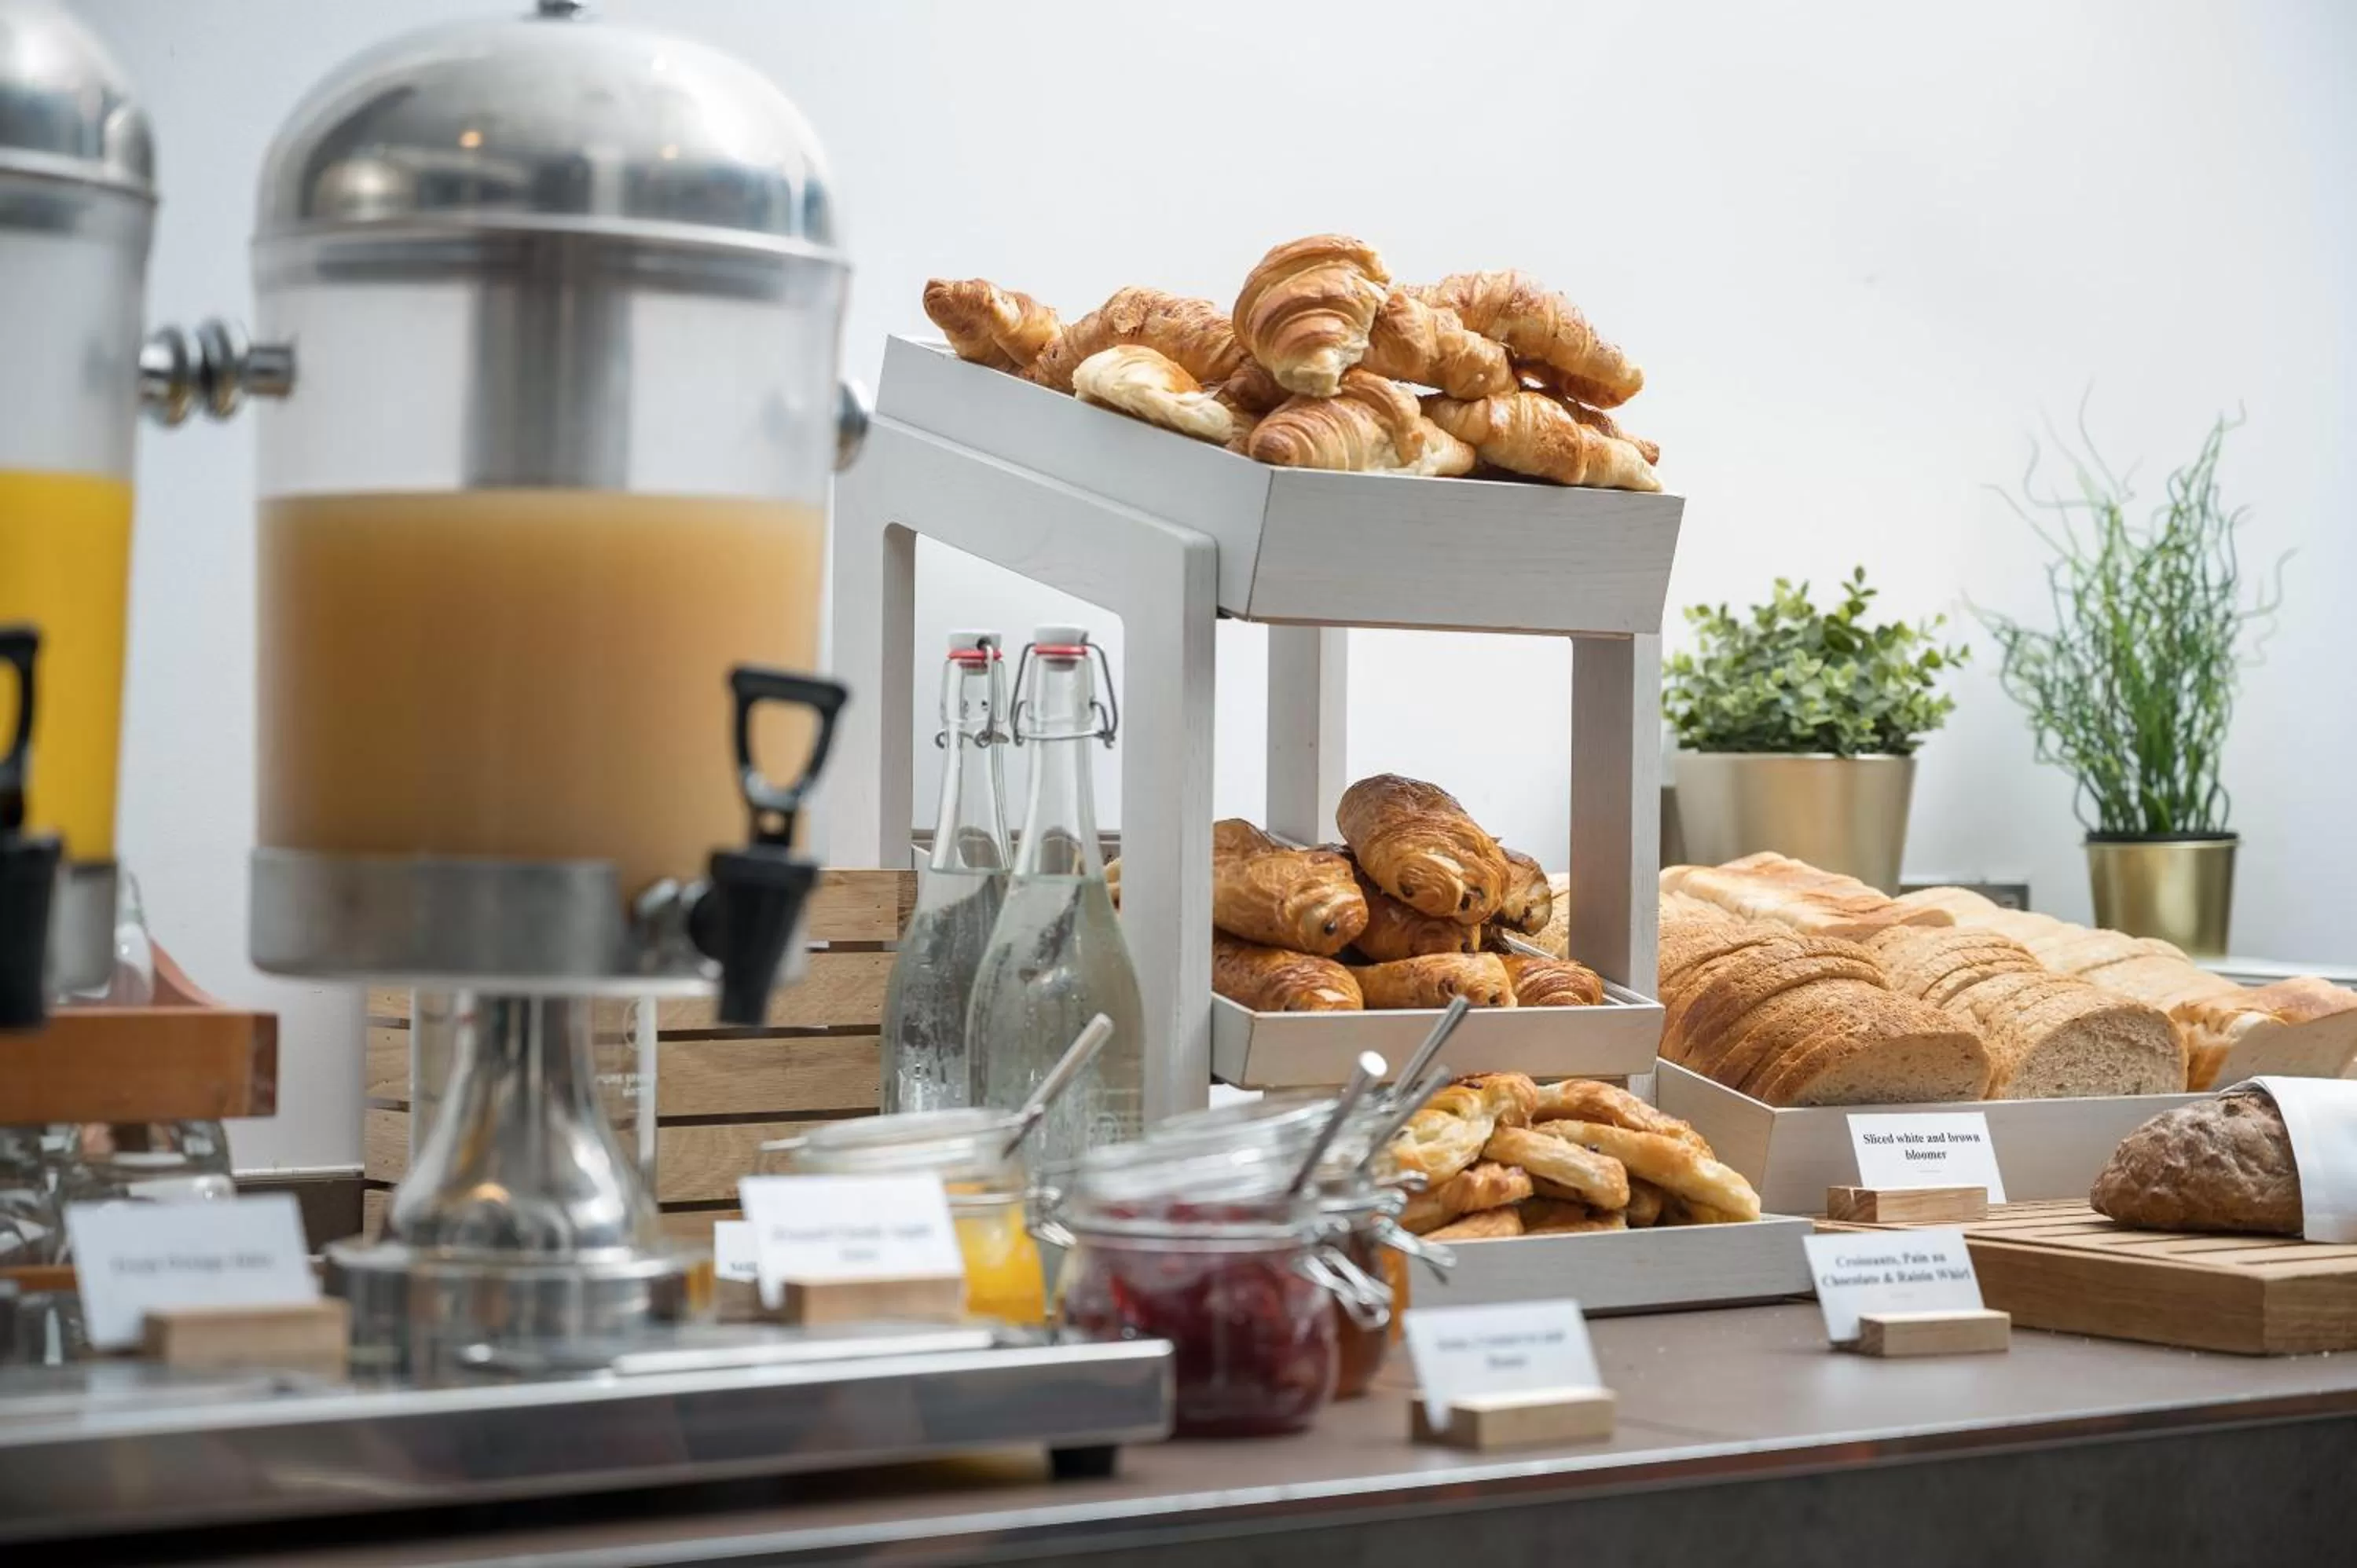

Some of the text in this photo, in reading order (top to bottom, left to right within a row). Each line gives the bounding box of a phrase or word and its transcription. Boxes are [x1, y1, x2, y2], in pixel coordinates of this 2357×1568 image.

[1863, 1132, 1981, 1145] Sliced white and brown
[1905, 1149, 1947, 1160] bloomer
[1902, 1252, 1929, 1264] Pain
[1822, 1273, 1880, 1287] Chocolate
[1884, 1272, 1893, 1284] &
